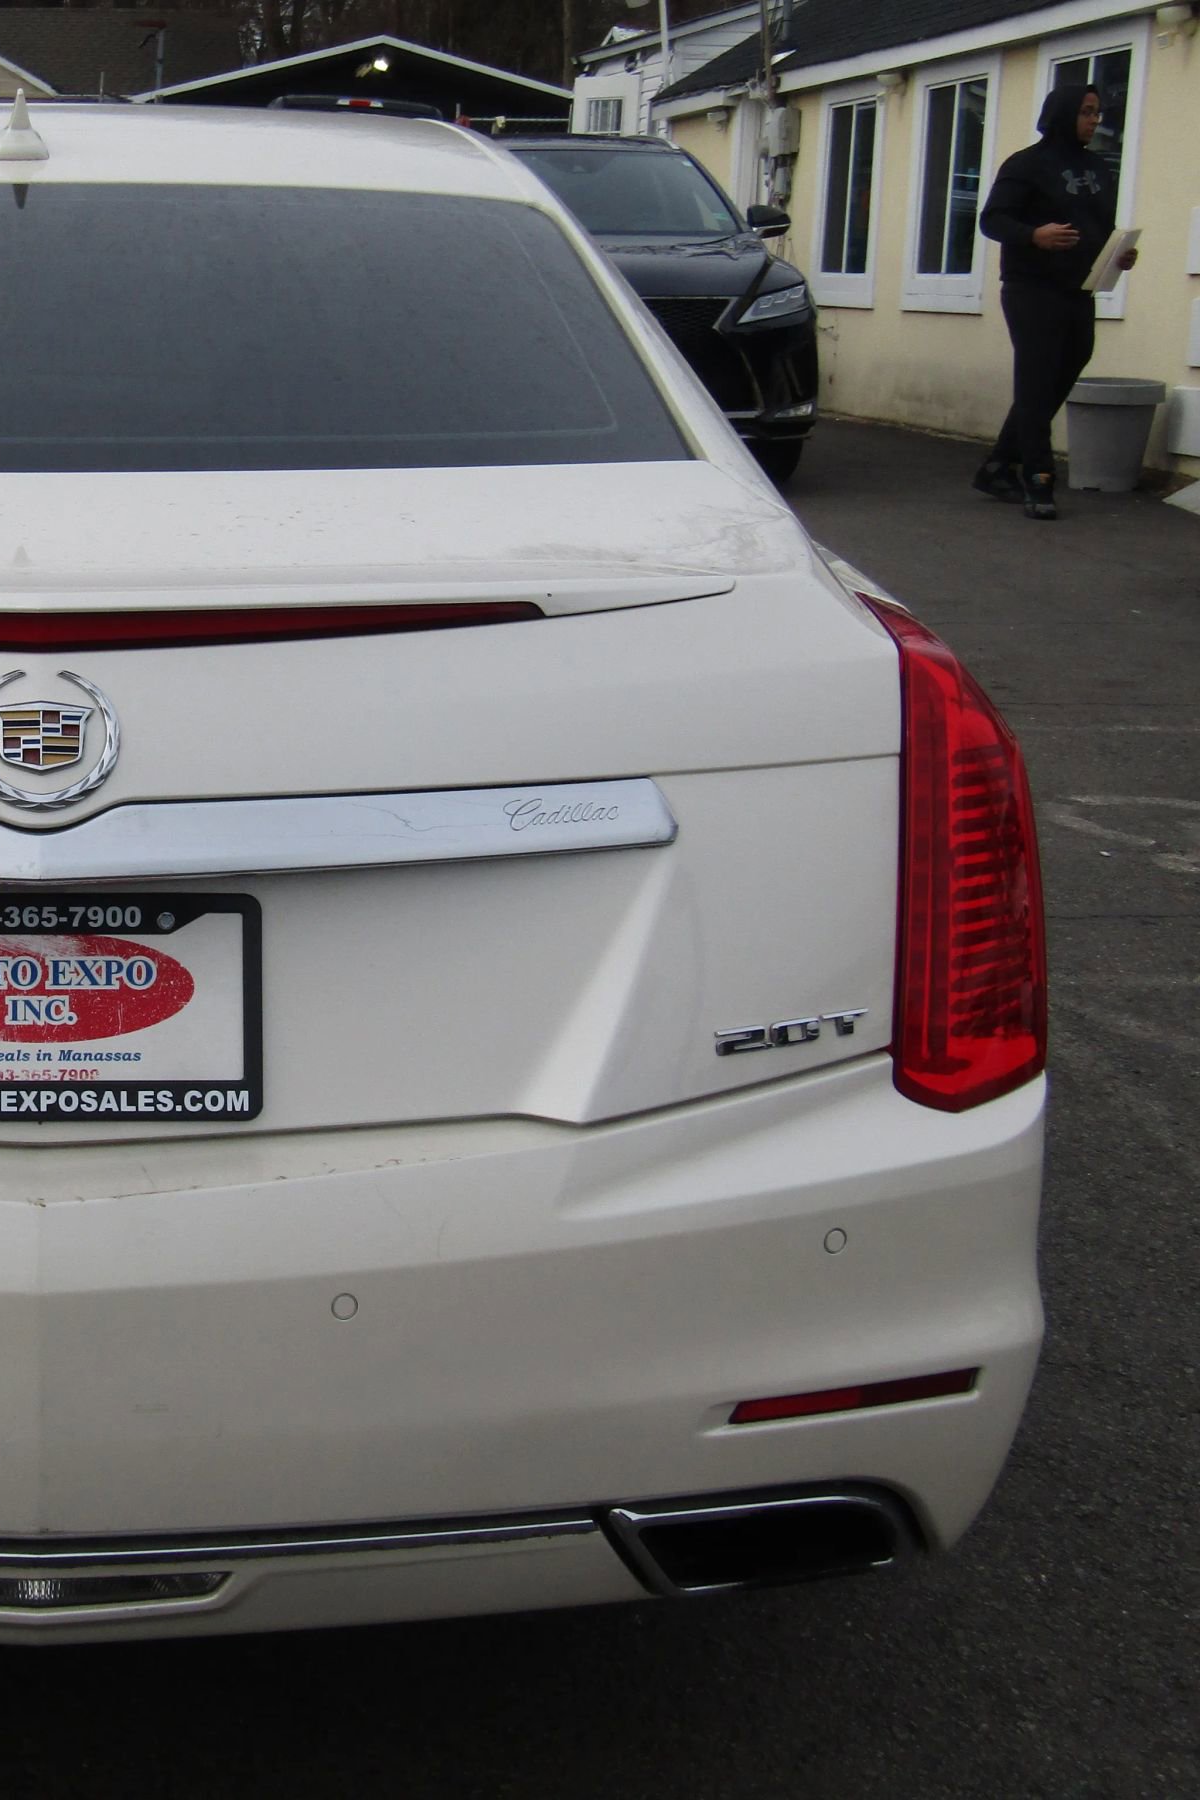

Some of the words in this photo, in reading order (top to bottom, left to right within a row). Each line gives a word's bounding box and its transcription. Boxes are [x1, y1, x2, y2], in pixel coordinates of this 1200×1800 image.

[502, 798, 620, 832] Cadillac
[46, 957, 156, 989] EXPO
[6, 996, 77, 1024] INC.
[36, 1049, 53, 1063] in
[57, 1049, 142, 1063] Manassas
